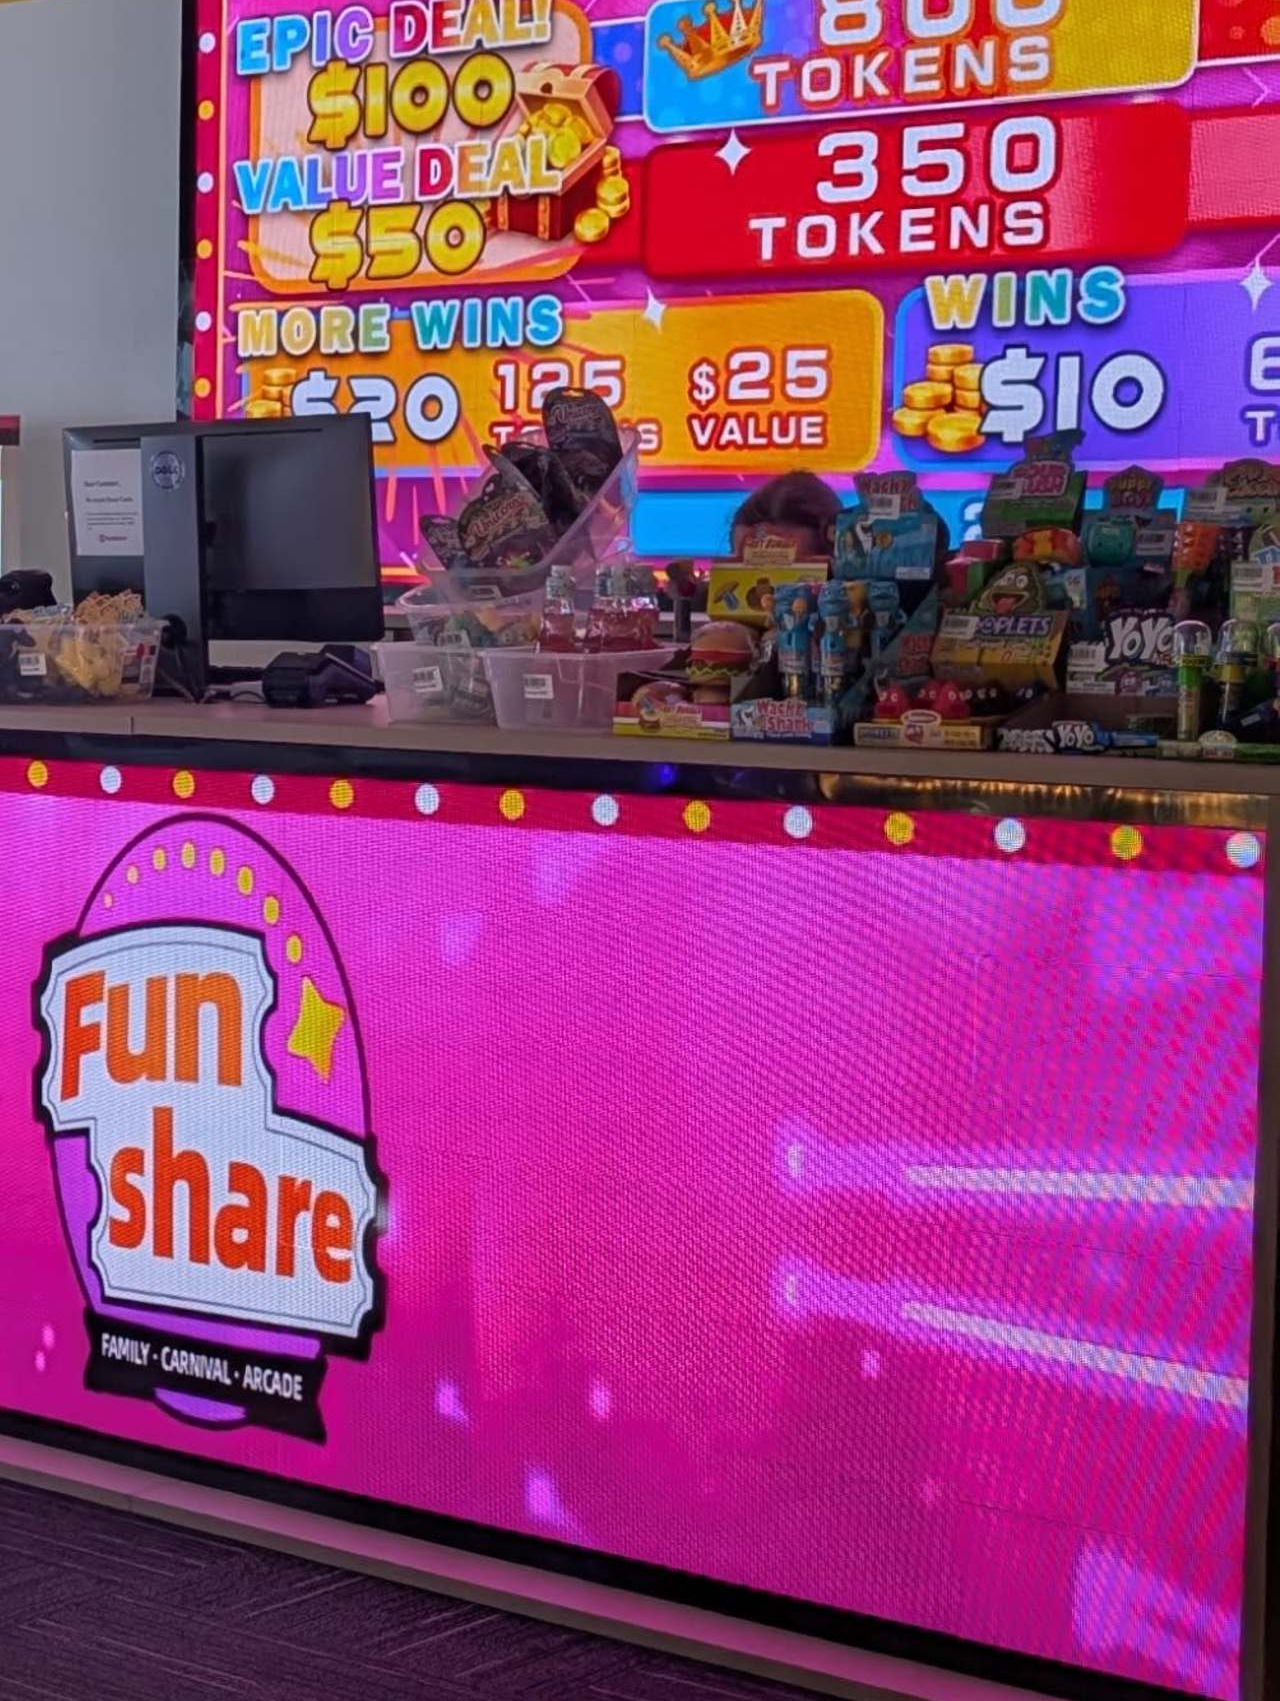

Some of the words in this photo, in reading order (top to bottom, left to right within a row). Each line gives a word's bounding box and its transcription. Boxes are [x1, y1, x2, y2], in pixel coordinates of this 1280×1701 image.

[236, 9, 374, 75] EPIC
[752, 38, 1053, 105] TOKENS
[306, 51, 515, 150] $100
[234, 146, 405, 215] VALUE
[413, 135, 561, 199] DEAL
[816, 115, 1058, 204] 350
[308, 199, 487, 292] $50
[749, 200, 1048, 261] TOKENS
[236, 304, 388, 357] MORE
[414, 294, 563, 347] WINS
[924, 265, 1126, 329] WINS
[494, 358, 623, 412] 125
[687, 347, 829, 406] $25
[979, 345, 1167, 443] $10
[690, 415, 825, 447] VALUE
[60, 969, 243, 1102] Fun
[107, 1106, 354, 1286] share
[101, 1332, 150, 1365] FAMILY
[160, 1345, 232, 1387] CARNIVAL
[242, 1366, 303, 1402] ARCADE
